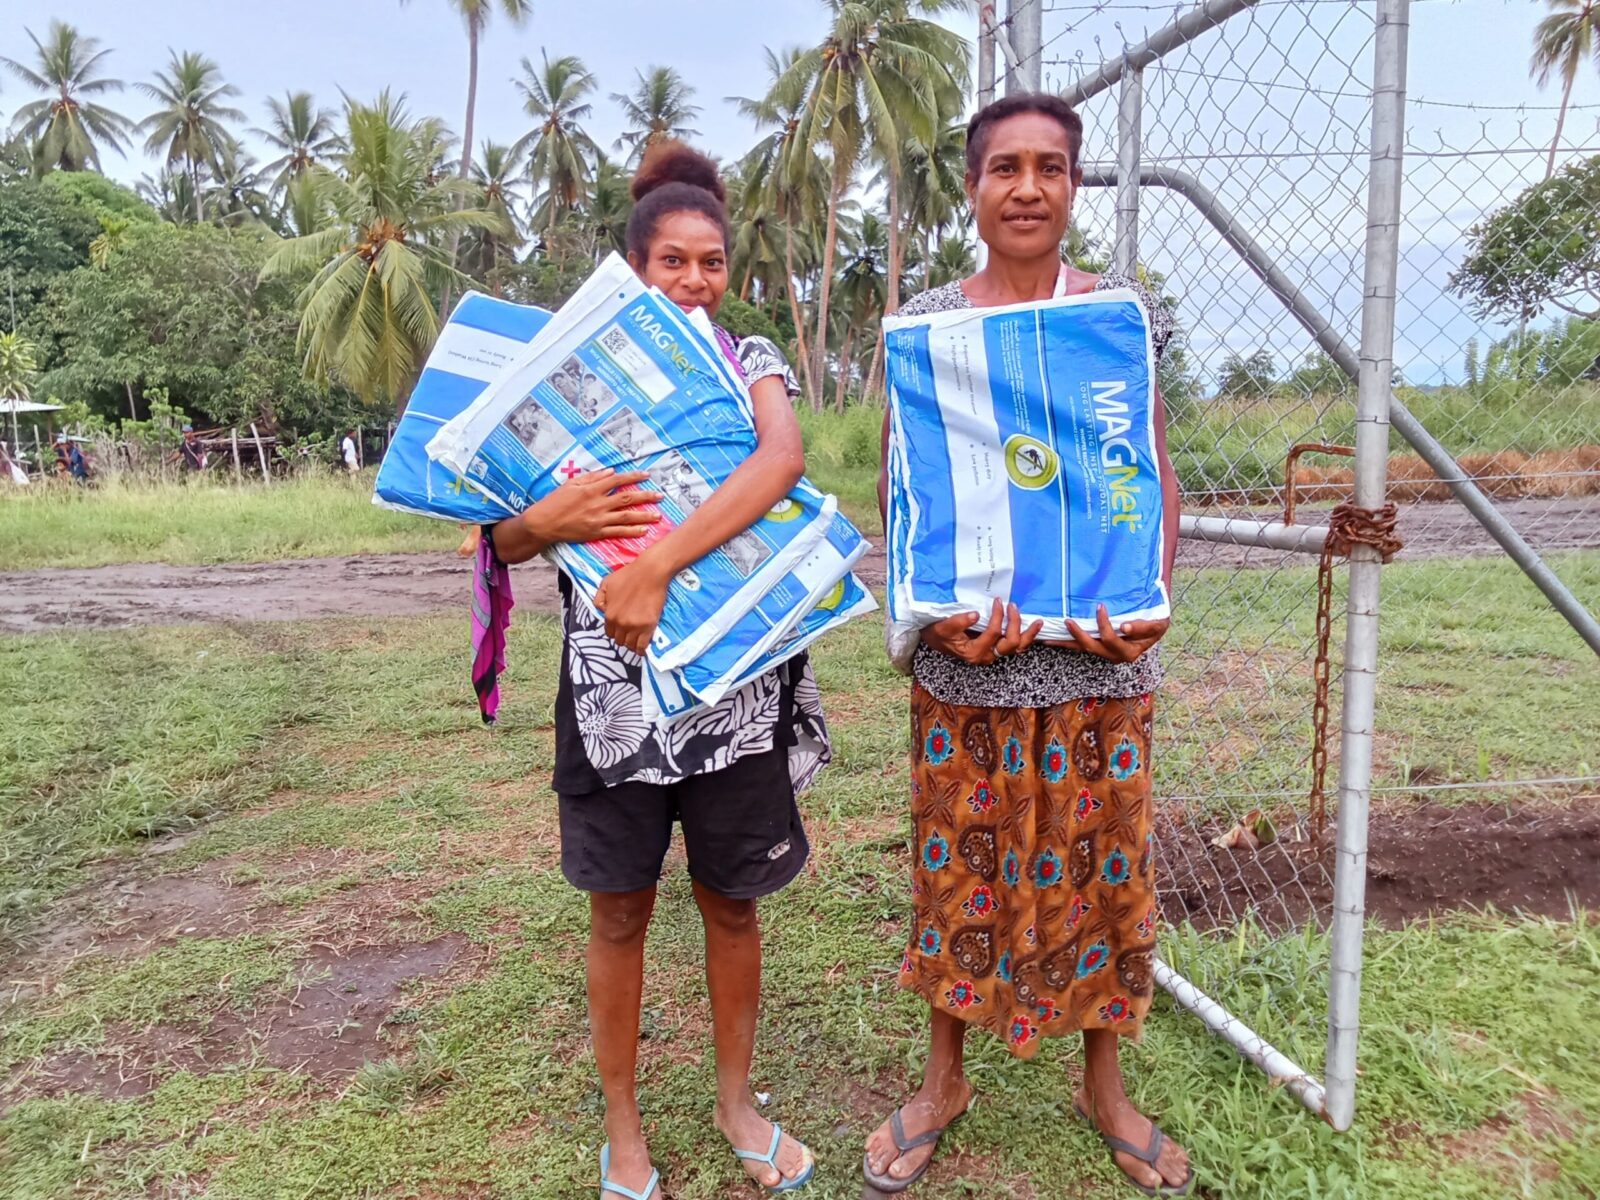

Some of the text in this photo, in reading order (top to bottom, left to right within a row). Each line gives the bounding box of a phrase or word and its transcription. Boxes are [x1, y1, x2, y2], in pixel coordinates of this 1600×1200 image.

[628, 302, 698, 378] MAGNet
[1079, 381, 1088, 404] LONG
[1083, 408, 1094, 446] LASTING
[1090, 379, 1142, 533] MAGNet
[1099, 515, 1107, 533] NET
